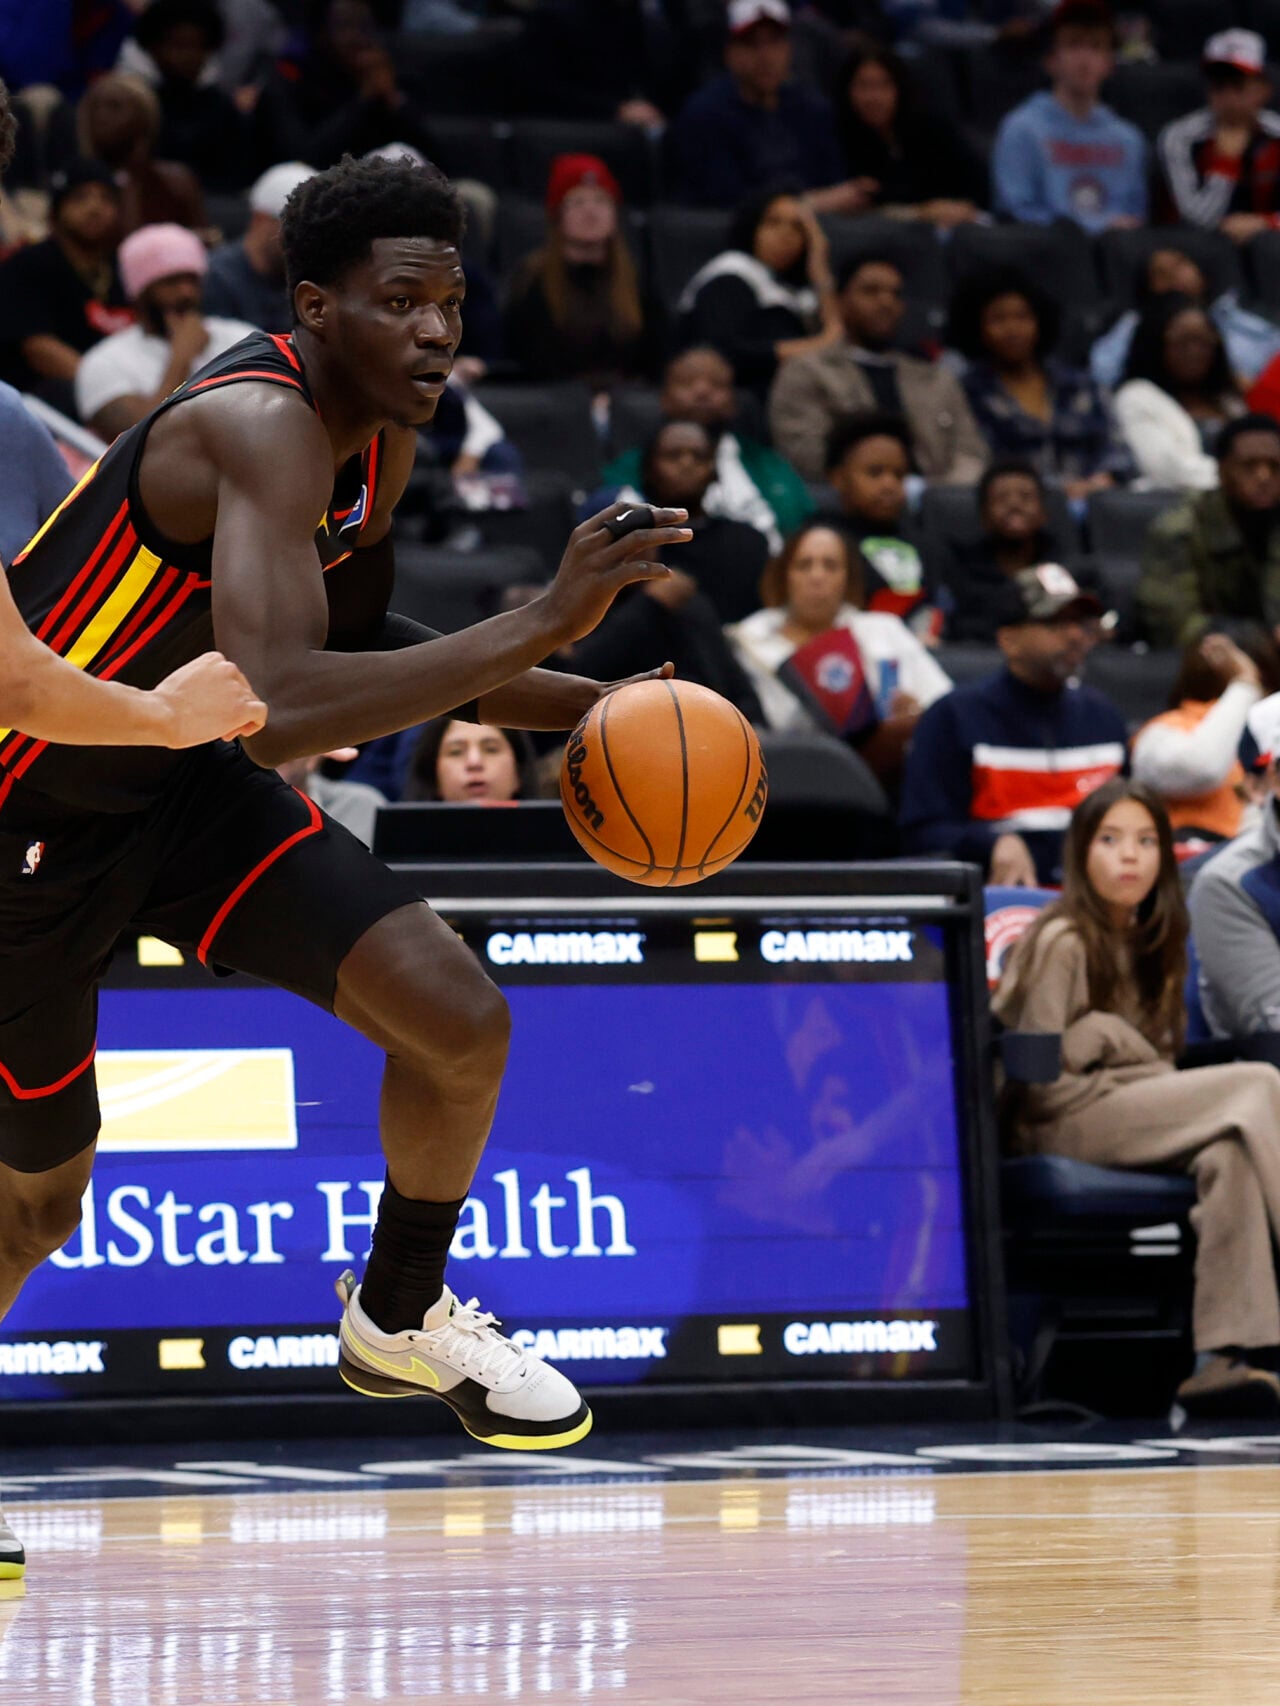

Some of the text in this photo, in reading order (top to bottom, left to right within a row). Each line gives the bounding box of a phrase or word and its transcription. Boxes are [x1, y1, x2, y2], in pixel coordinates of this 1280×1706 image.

[48, 1167, 637, 1269] dStar Halth
[229, 1334, 340, 1368] CARm
